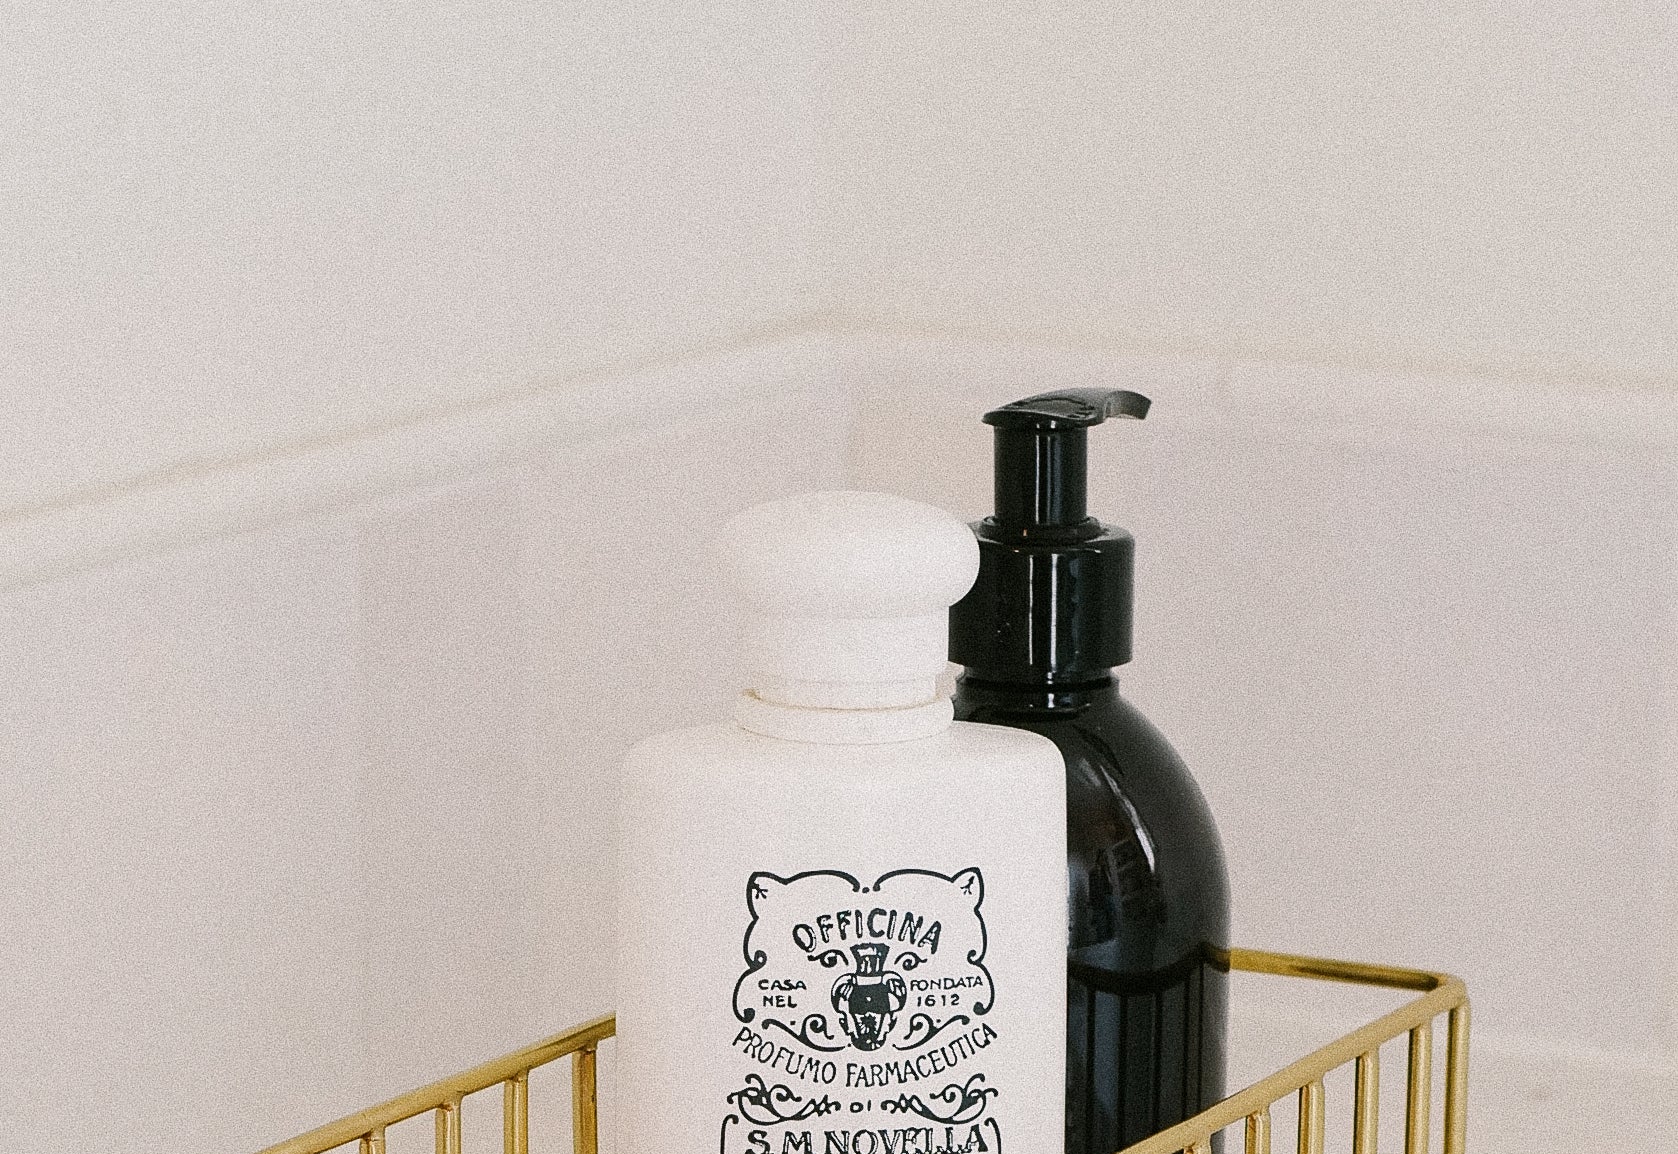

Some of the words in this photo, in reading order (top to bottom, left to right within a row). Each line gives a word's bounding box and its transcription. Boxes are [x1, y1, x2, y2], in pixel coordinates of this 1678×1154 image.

[792, 907, 942, 955] OFFICINA
[758, 978, 807, 992] CASA
[910, 975, 984, 992] FONDATA
[762, 995, 798, 1009] NEL
[916, 993, 960, 1007] 1612
[732, 1026, 837, 1085] PROFUMO
[845, 1022, 998, 1088] FARMACEUTICA
